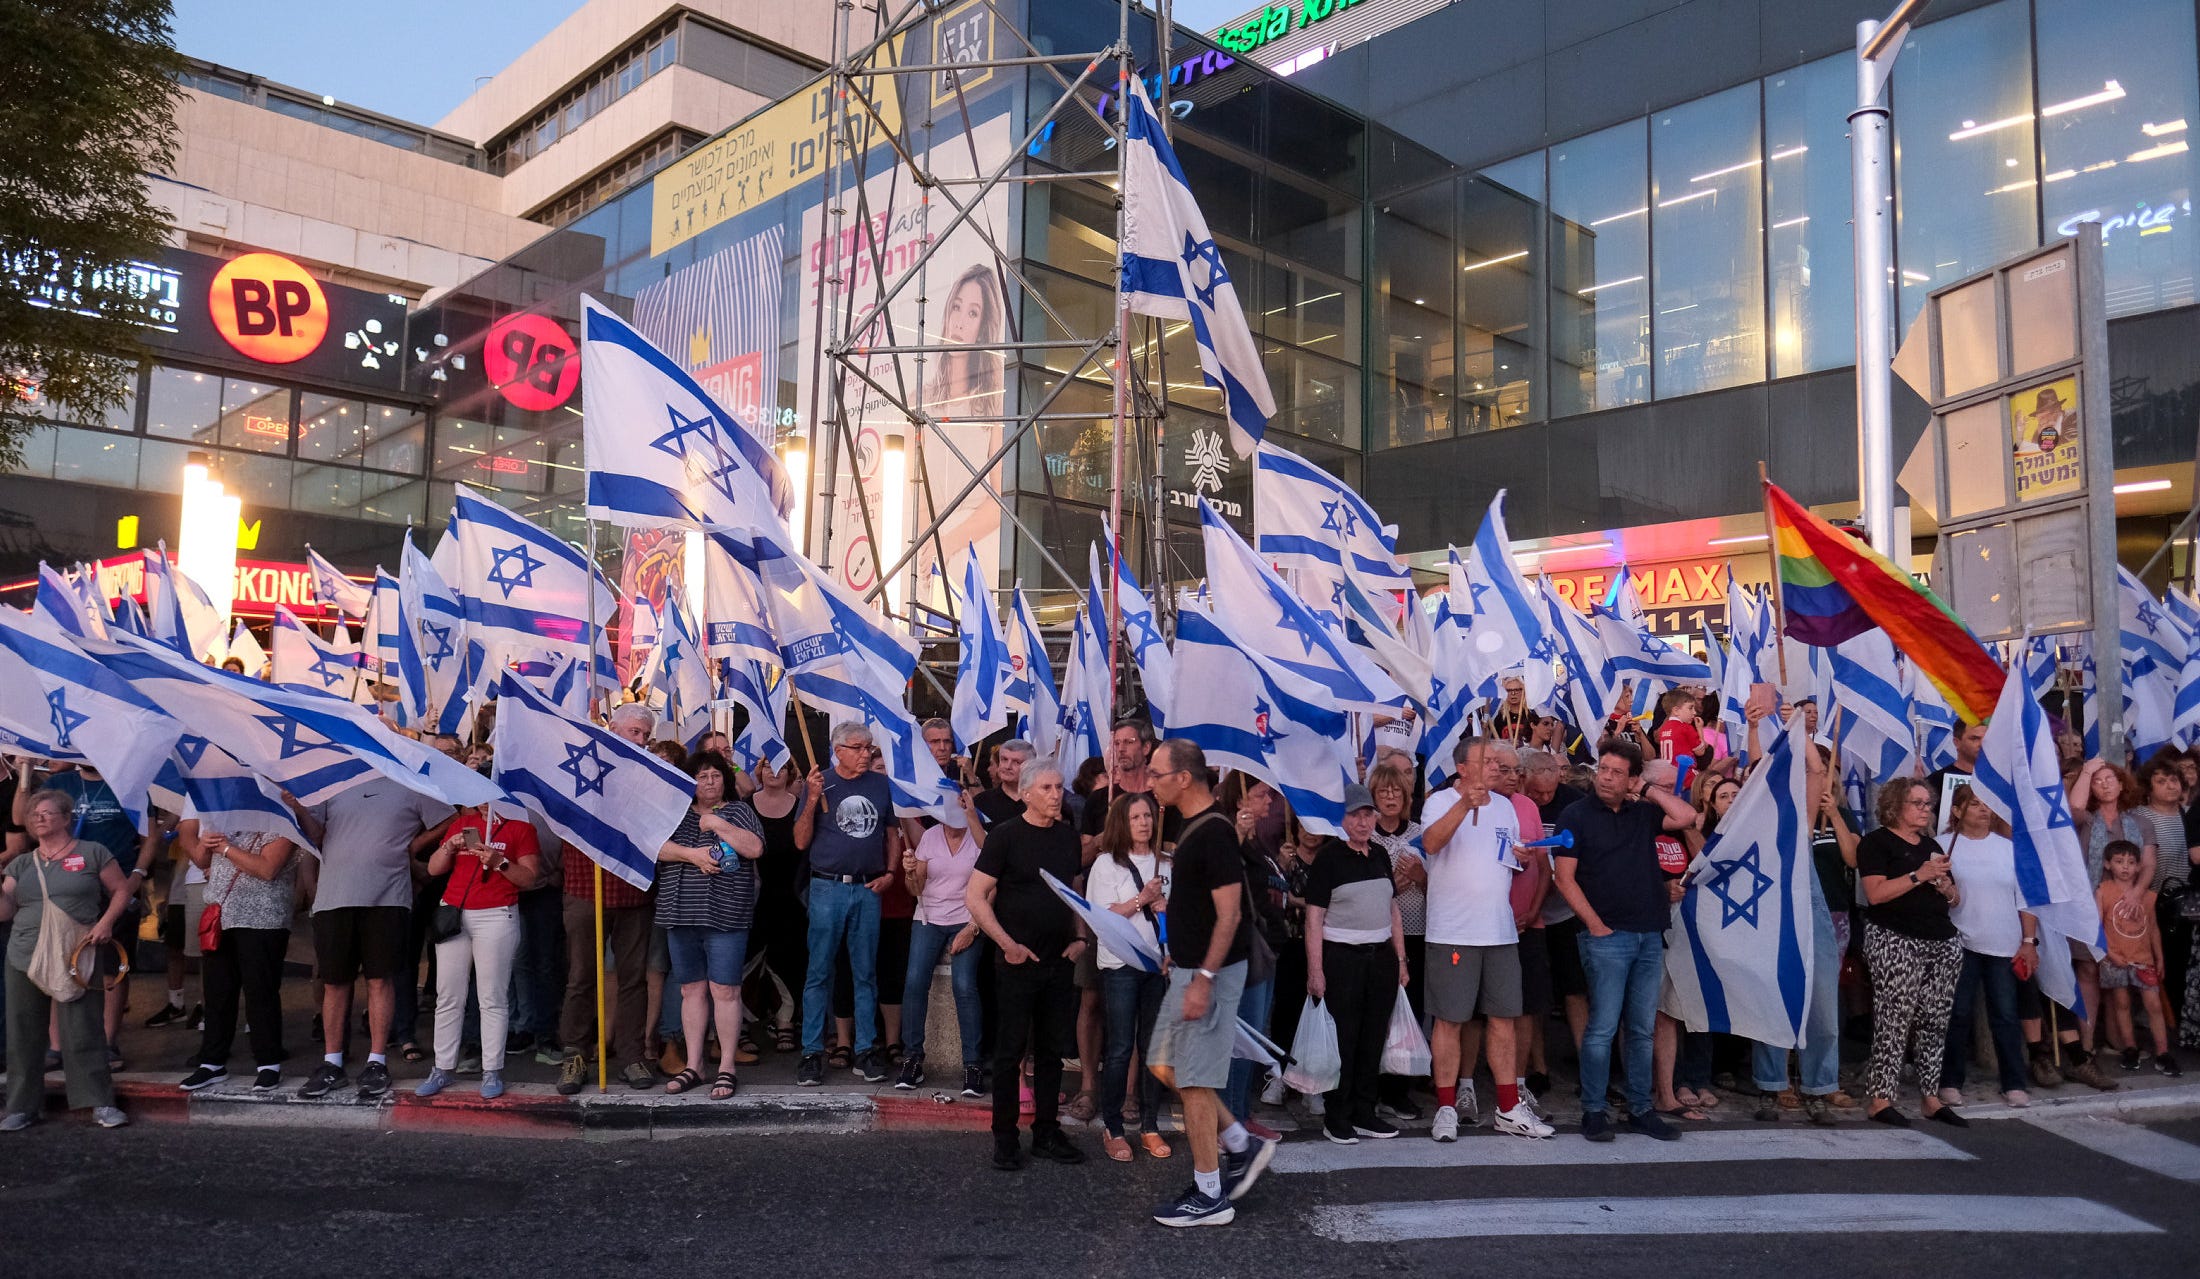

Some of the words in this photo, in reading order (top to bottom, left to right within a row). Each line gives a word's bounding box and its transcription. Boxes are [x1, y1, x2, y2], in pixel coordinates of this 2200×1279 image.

[943, 12, 983, 58] FIT
[1217, 6, 1289, 52] issta
[687, 144, 722, 179] לכושר
[725, 128, 756, 156] מרכז
[725, 139, 775, 181] ואימונים
[671, 167, 722, 210] קבוצתיים
[231, 278, 311, 337] BP
[2016, 452, 2056, 475] המלך
[2016, 462, 2080, 492] המשיח
